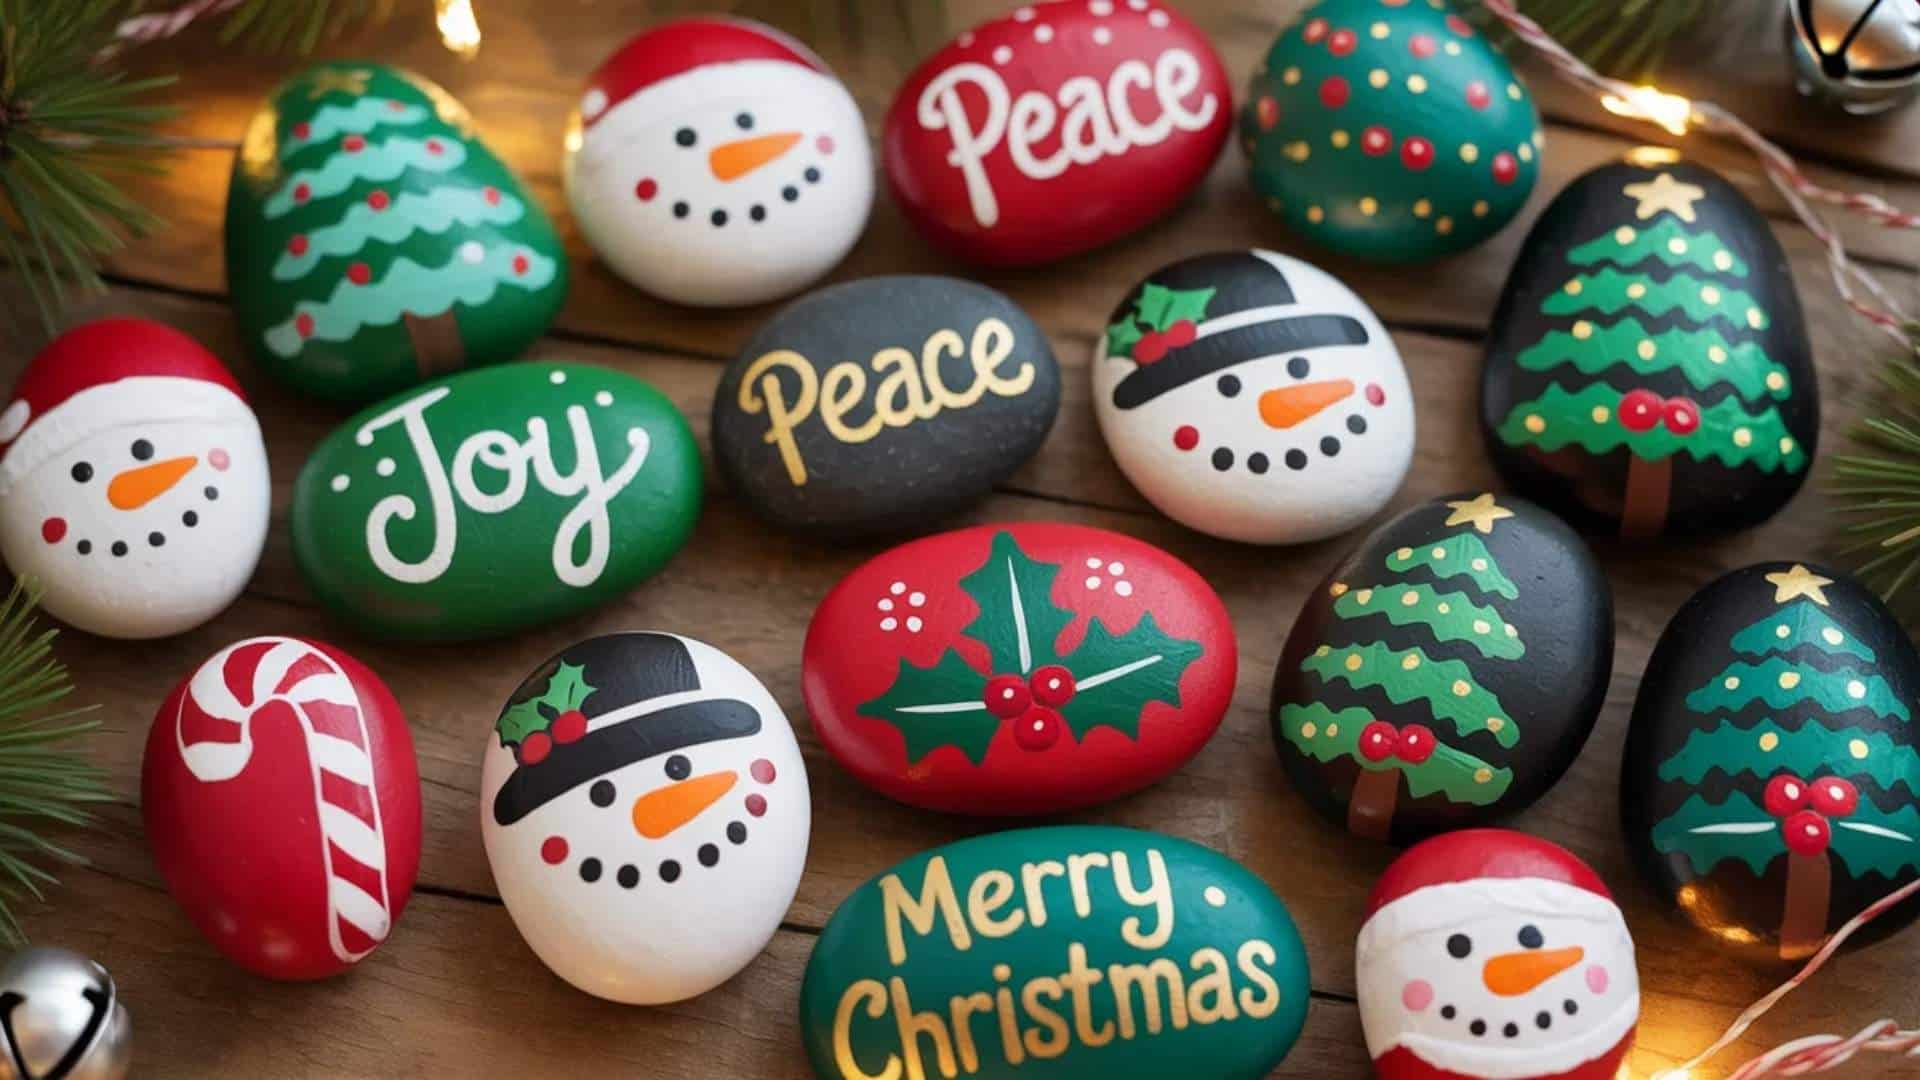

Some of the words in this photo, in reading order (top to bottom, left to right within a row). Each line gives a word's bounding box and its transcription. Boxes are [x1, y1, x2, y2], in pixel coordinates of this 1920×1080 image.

[917, 48, 1218, 227] Peace
[738, 317, 1036, 486] Peace
[355, 386, 651, 588] Joy
[879, 848, 1175, 965] Merry
[833, 939, 1281, 1080] Christmas
